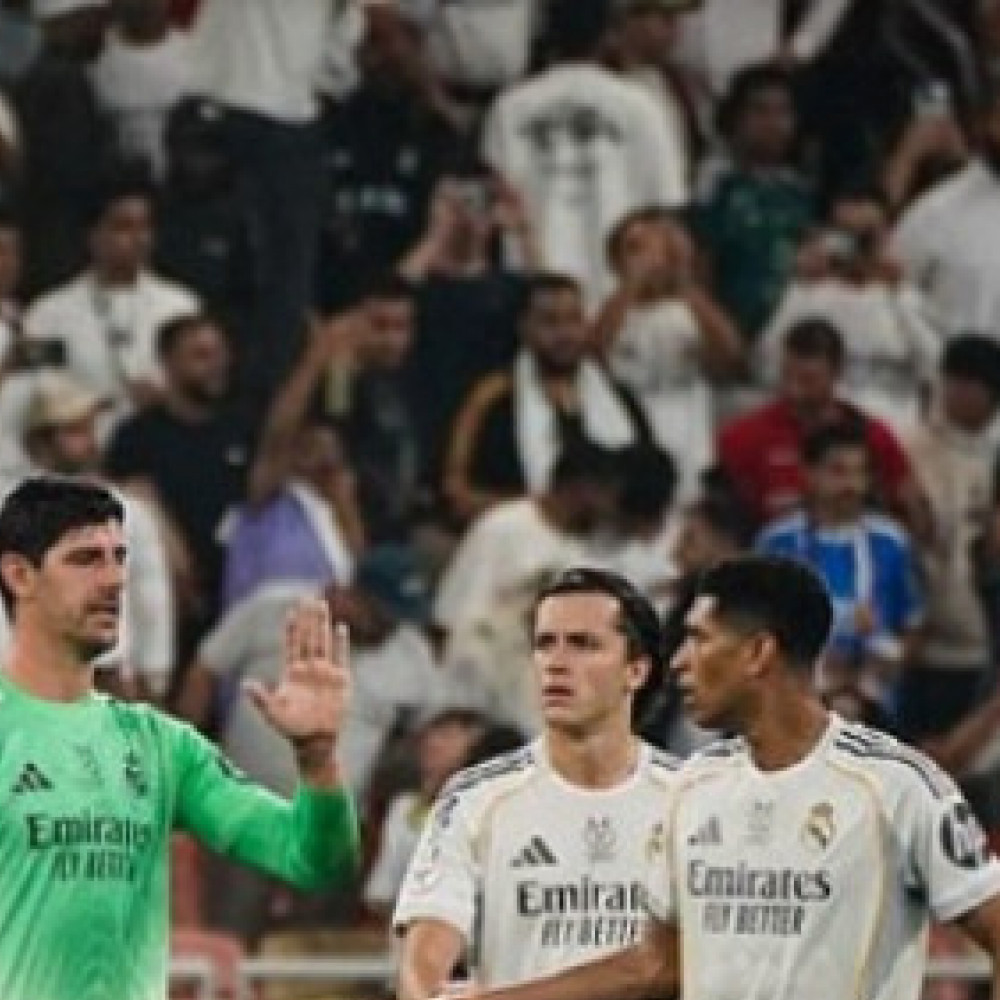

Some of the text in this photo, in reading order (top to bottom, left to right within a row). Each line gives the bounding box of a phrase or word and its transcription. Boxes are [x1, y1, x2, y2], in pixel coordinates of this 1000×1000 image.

[515, 874, 648, 917] Emirat
[687, 860, 832, 901] Emirates
[736, 903, 804, 935] BETTER
